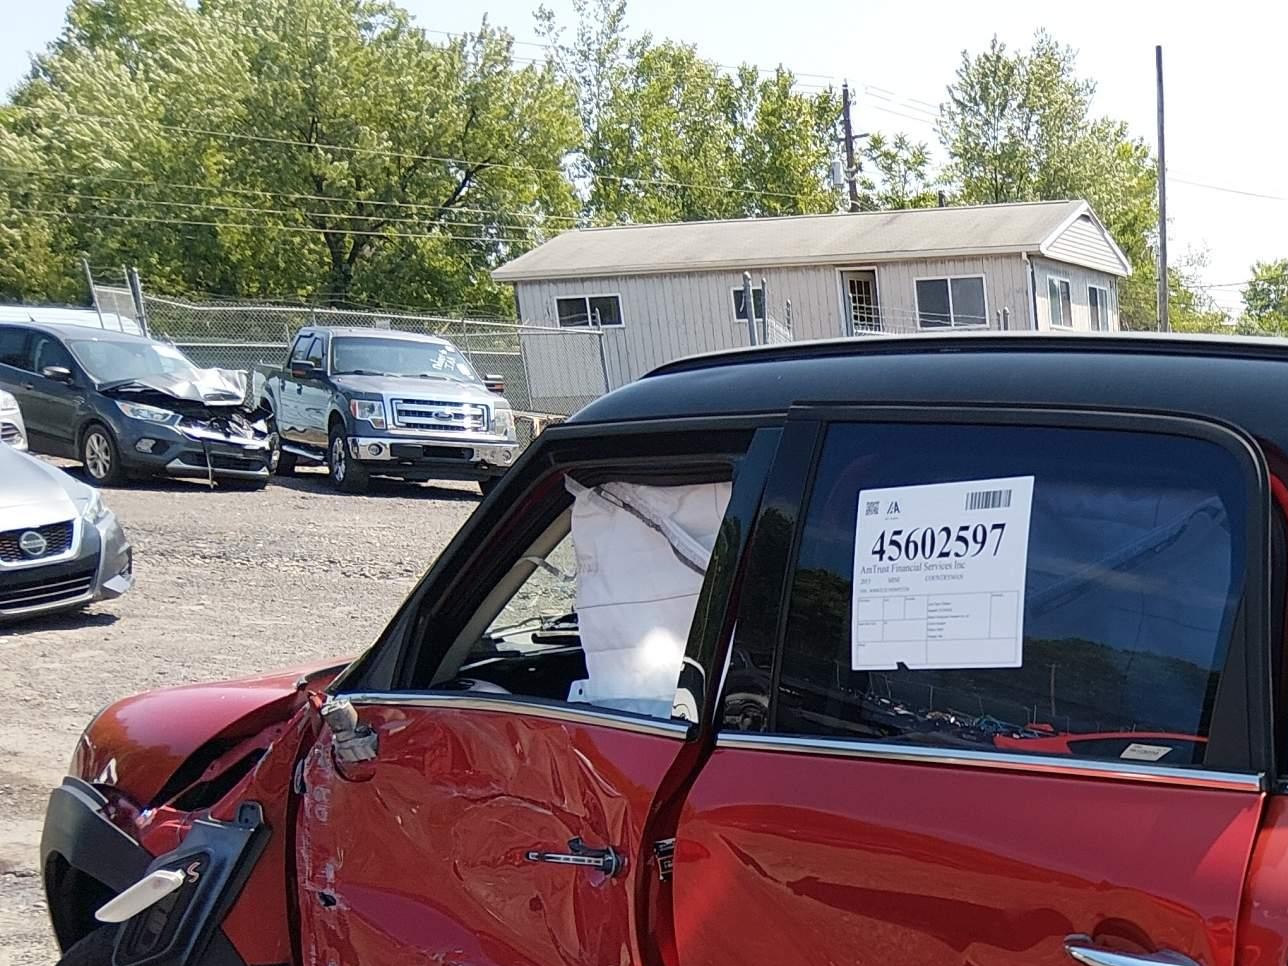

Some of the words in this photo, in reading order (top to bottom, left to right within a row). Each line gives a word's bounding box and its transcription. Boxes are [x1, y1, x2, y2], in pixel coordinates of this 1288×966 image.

[871, 523, 1006, 562] 45602597
[861, 565, 890, 575] AmTrust
[892, 563, 922, 573] Financial
[924, 561, 953, 571] Services
[955, 560, 966, 569] Inc
[186, 861, 200, 883] S
